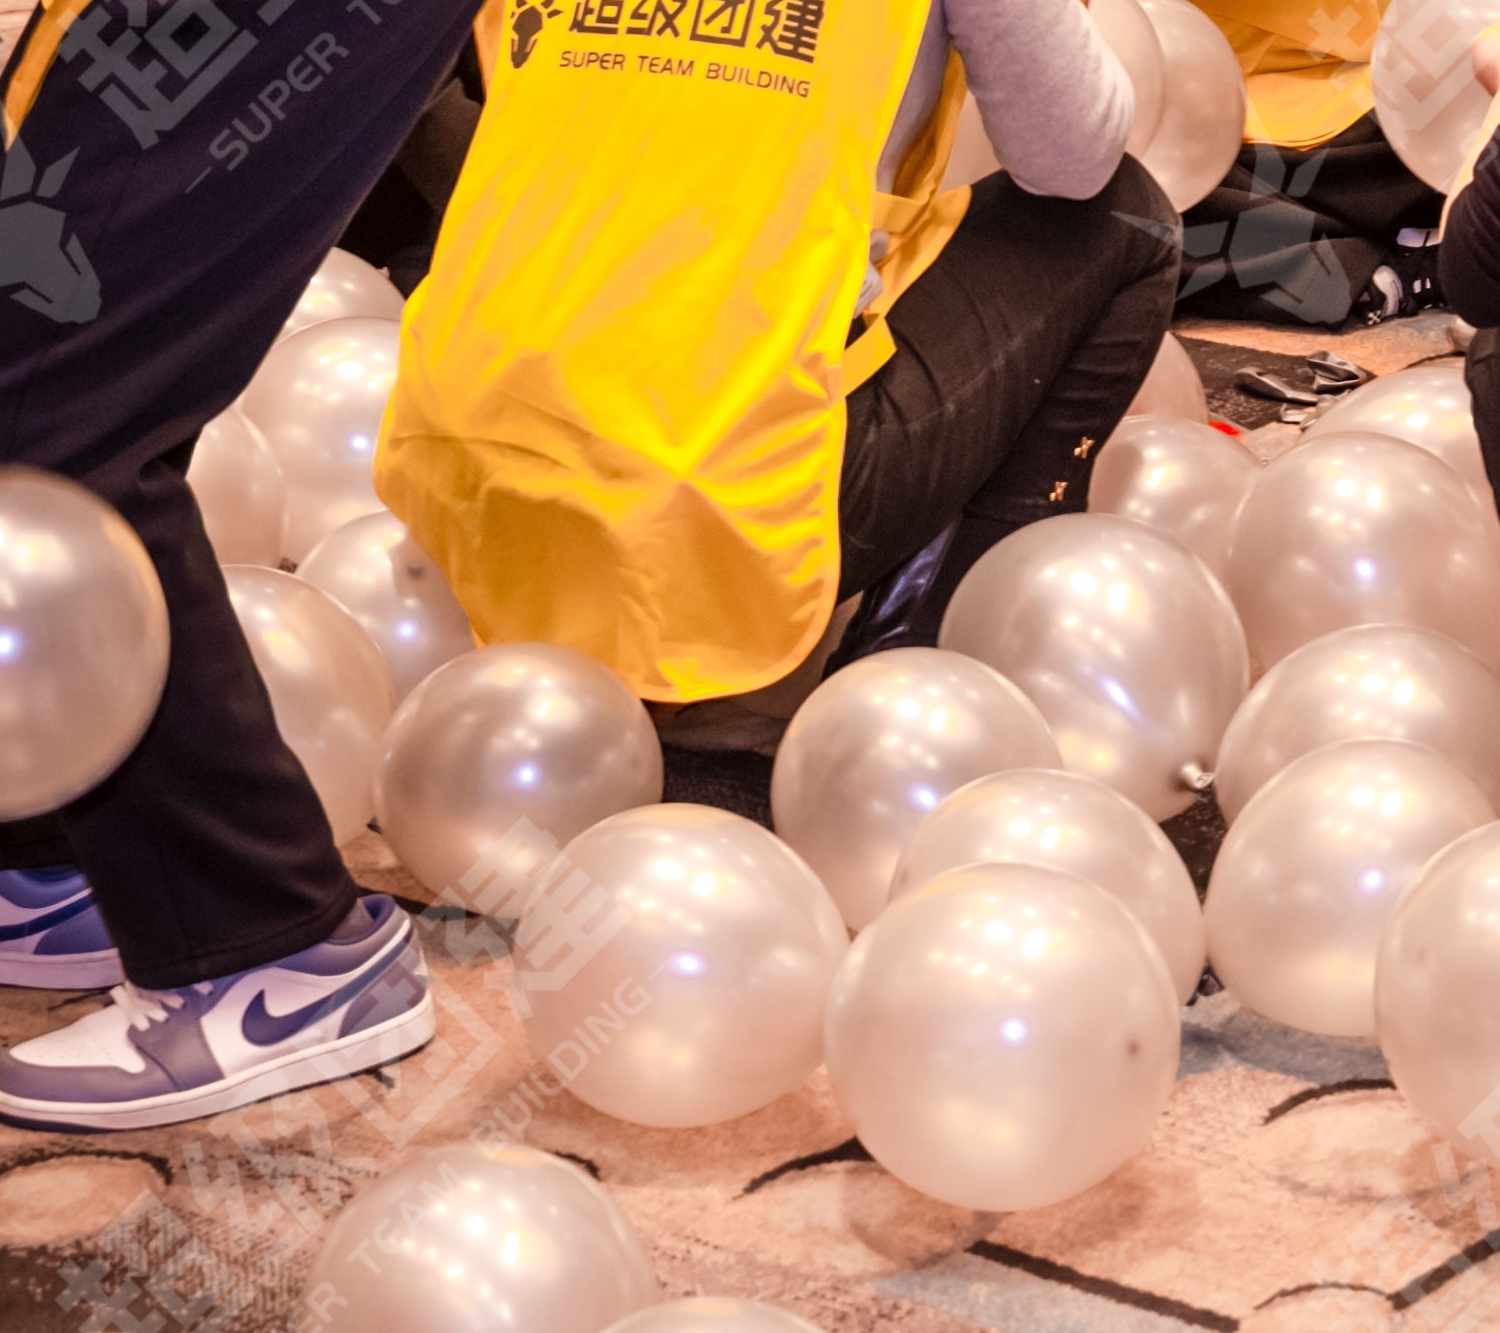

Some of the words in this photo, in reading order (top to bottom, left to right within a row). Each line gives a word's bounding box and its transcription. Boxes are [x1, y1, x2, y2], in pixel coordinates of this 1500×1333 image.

[560, 50, 625, 71] SUPER
[637, 54, 695, 77] TEAM
[706, 62, 811, 99] BUILDING
